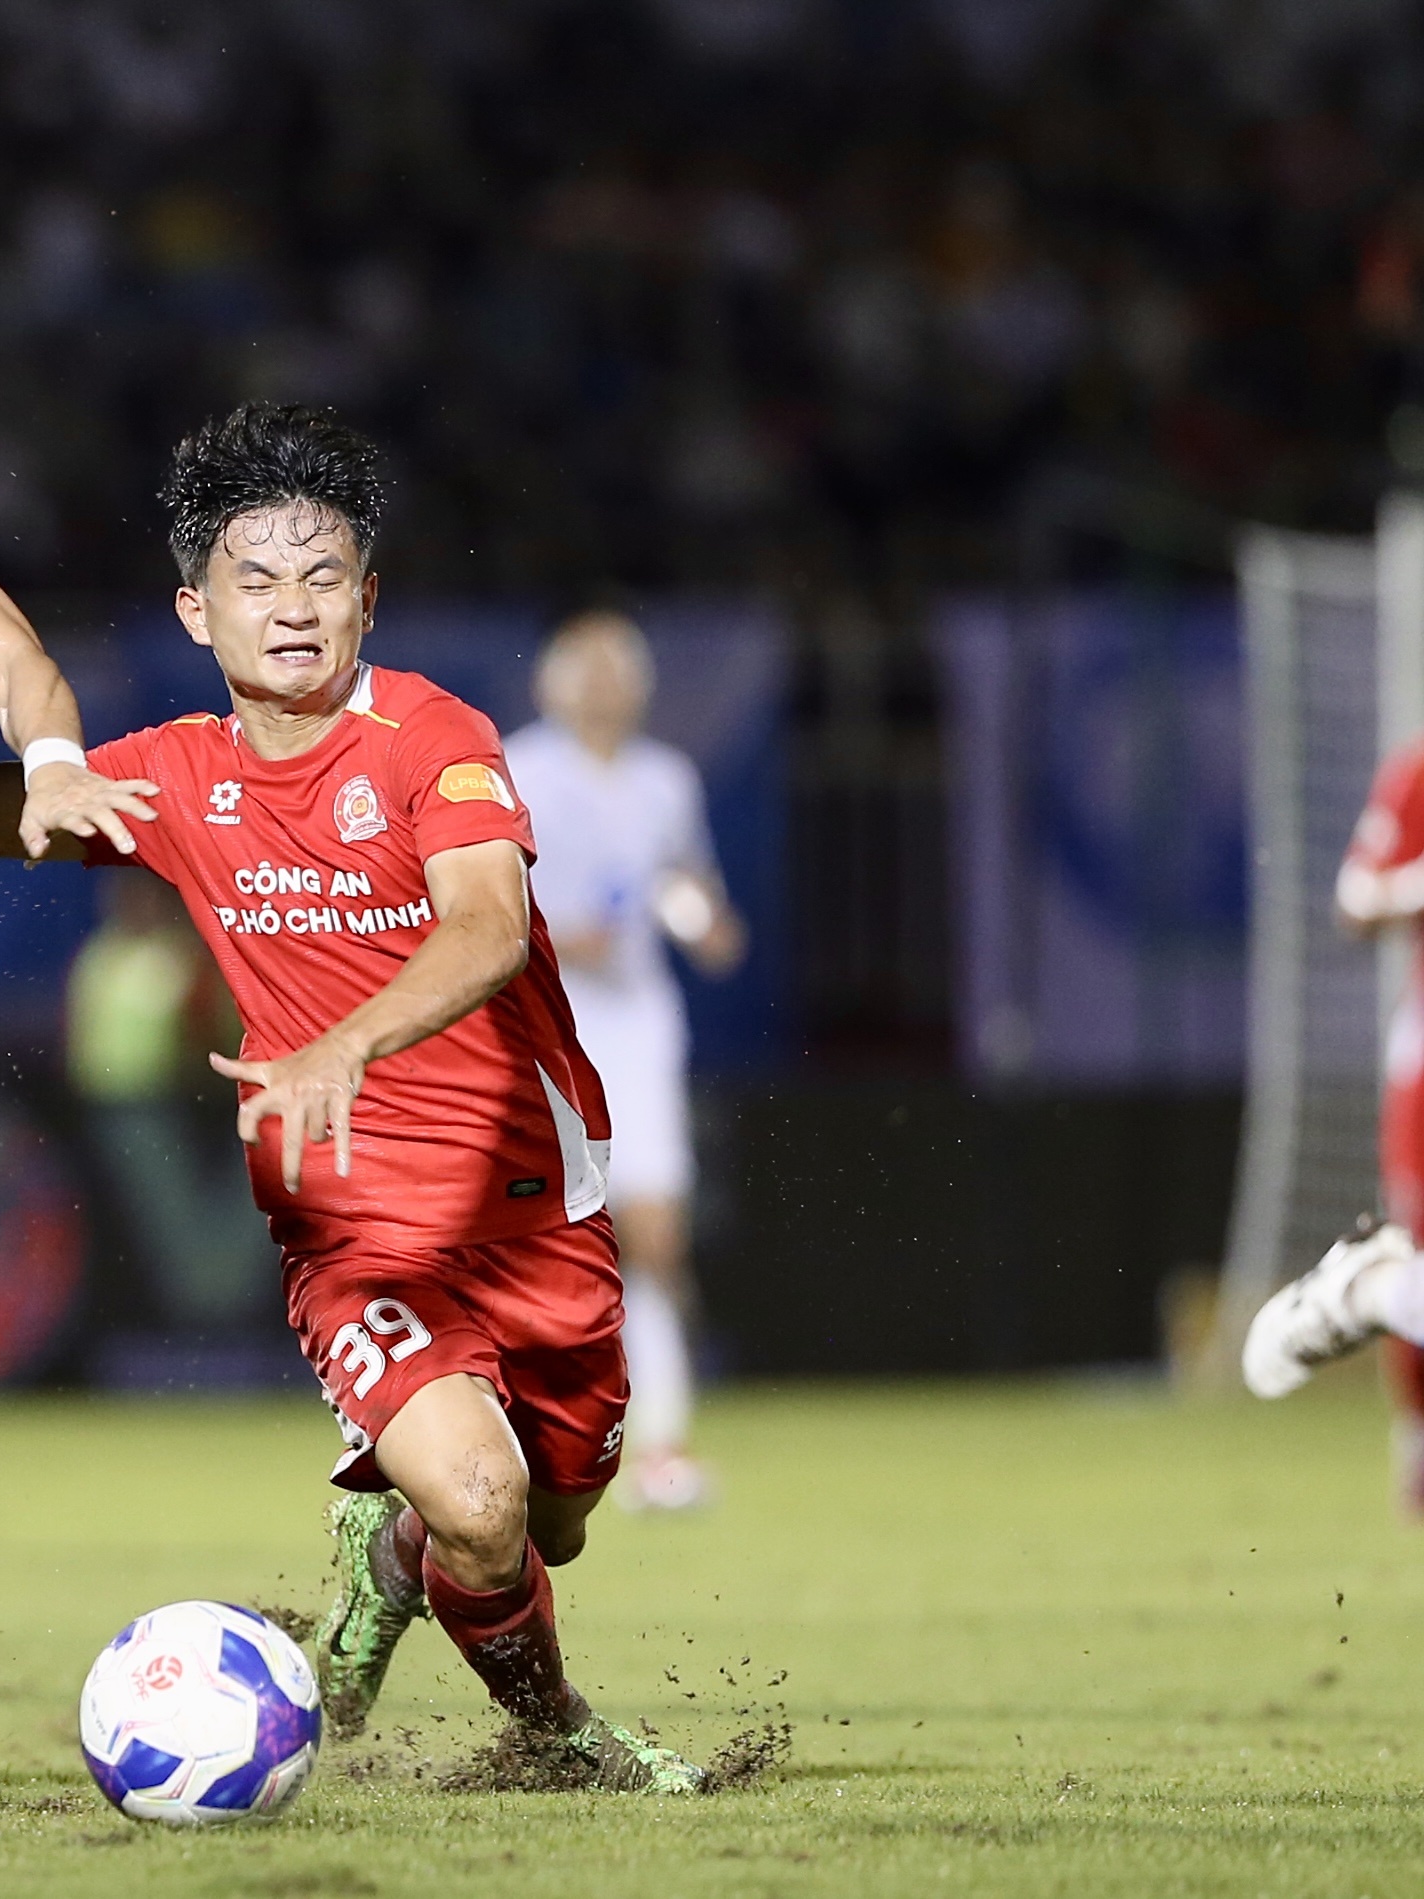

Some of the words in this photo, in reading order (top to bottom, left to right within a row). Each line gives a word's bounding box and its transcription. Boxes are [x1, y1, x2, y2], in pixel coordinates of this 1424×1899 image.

[234, 860, 322, 896] CÔNG
[329, 870, 373, 897] AN
[345, 896, 433, 936] MINH
[328, 1297, 433, 1401] 39
